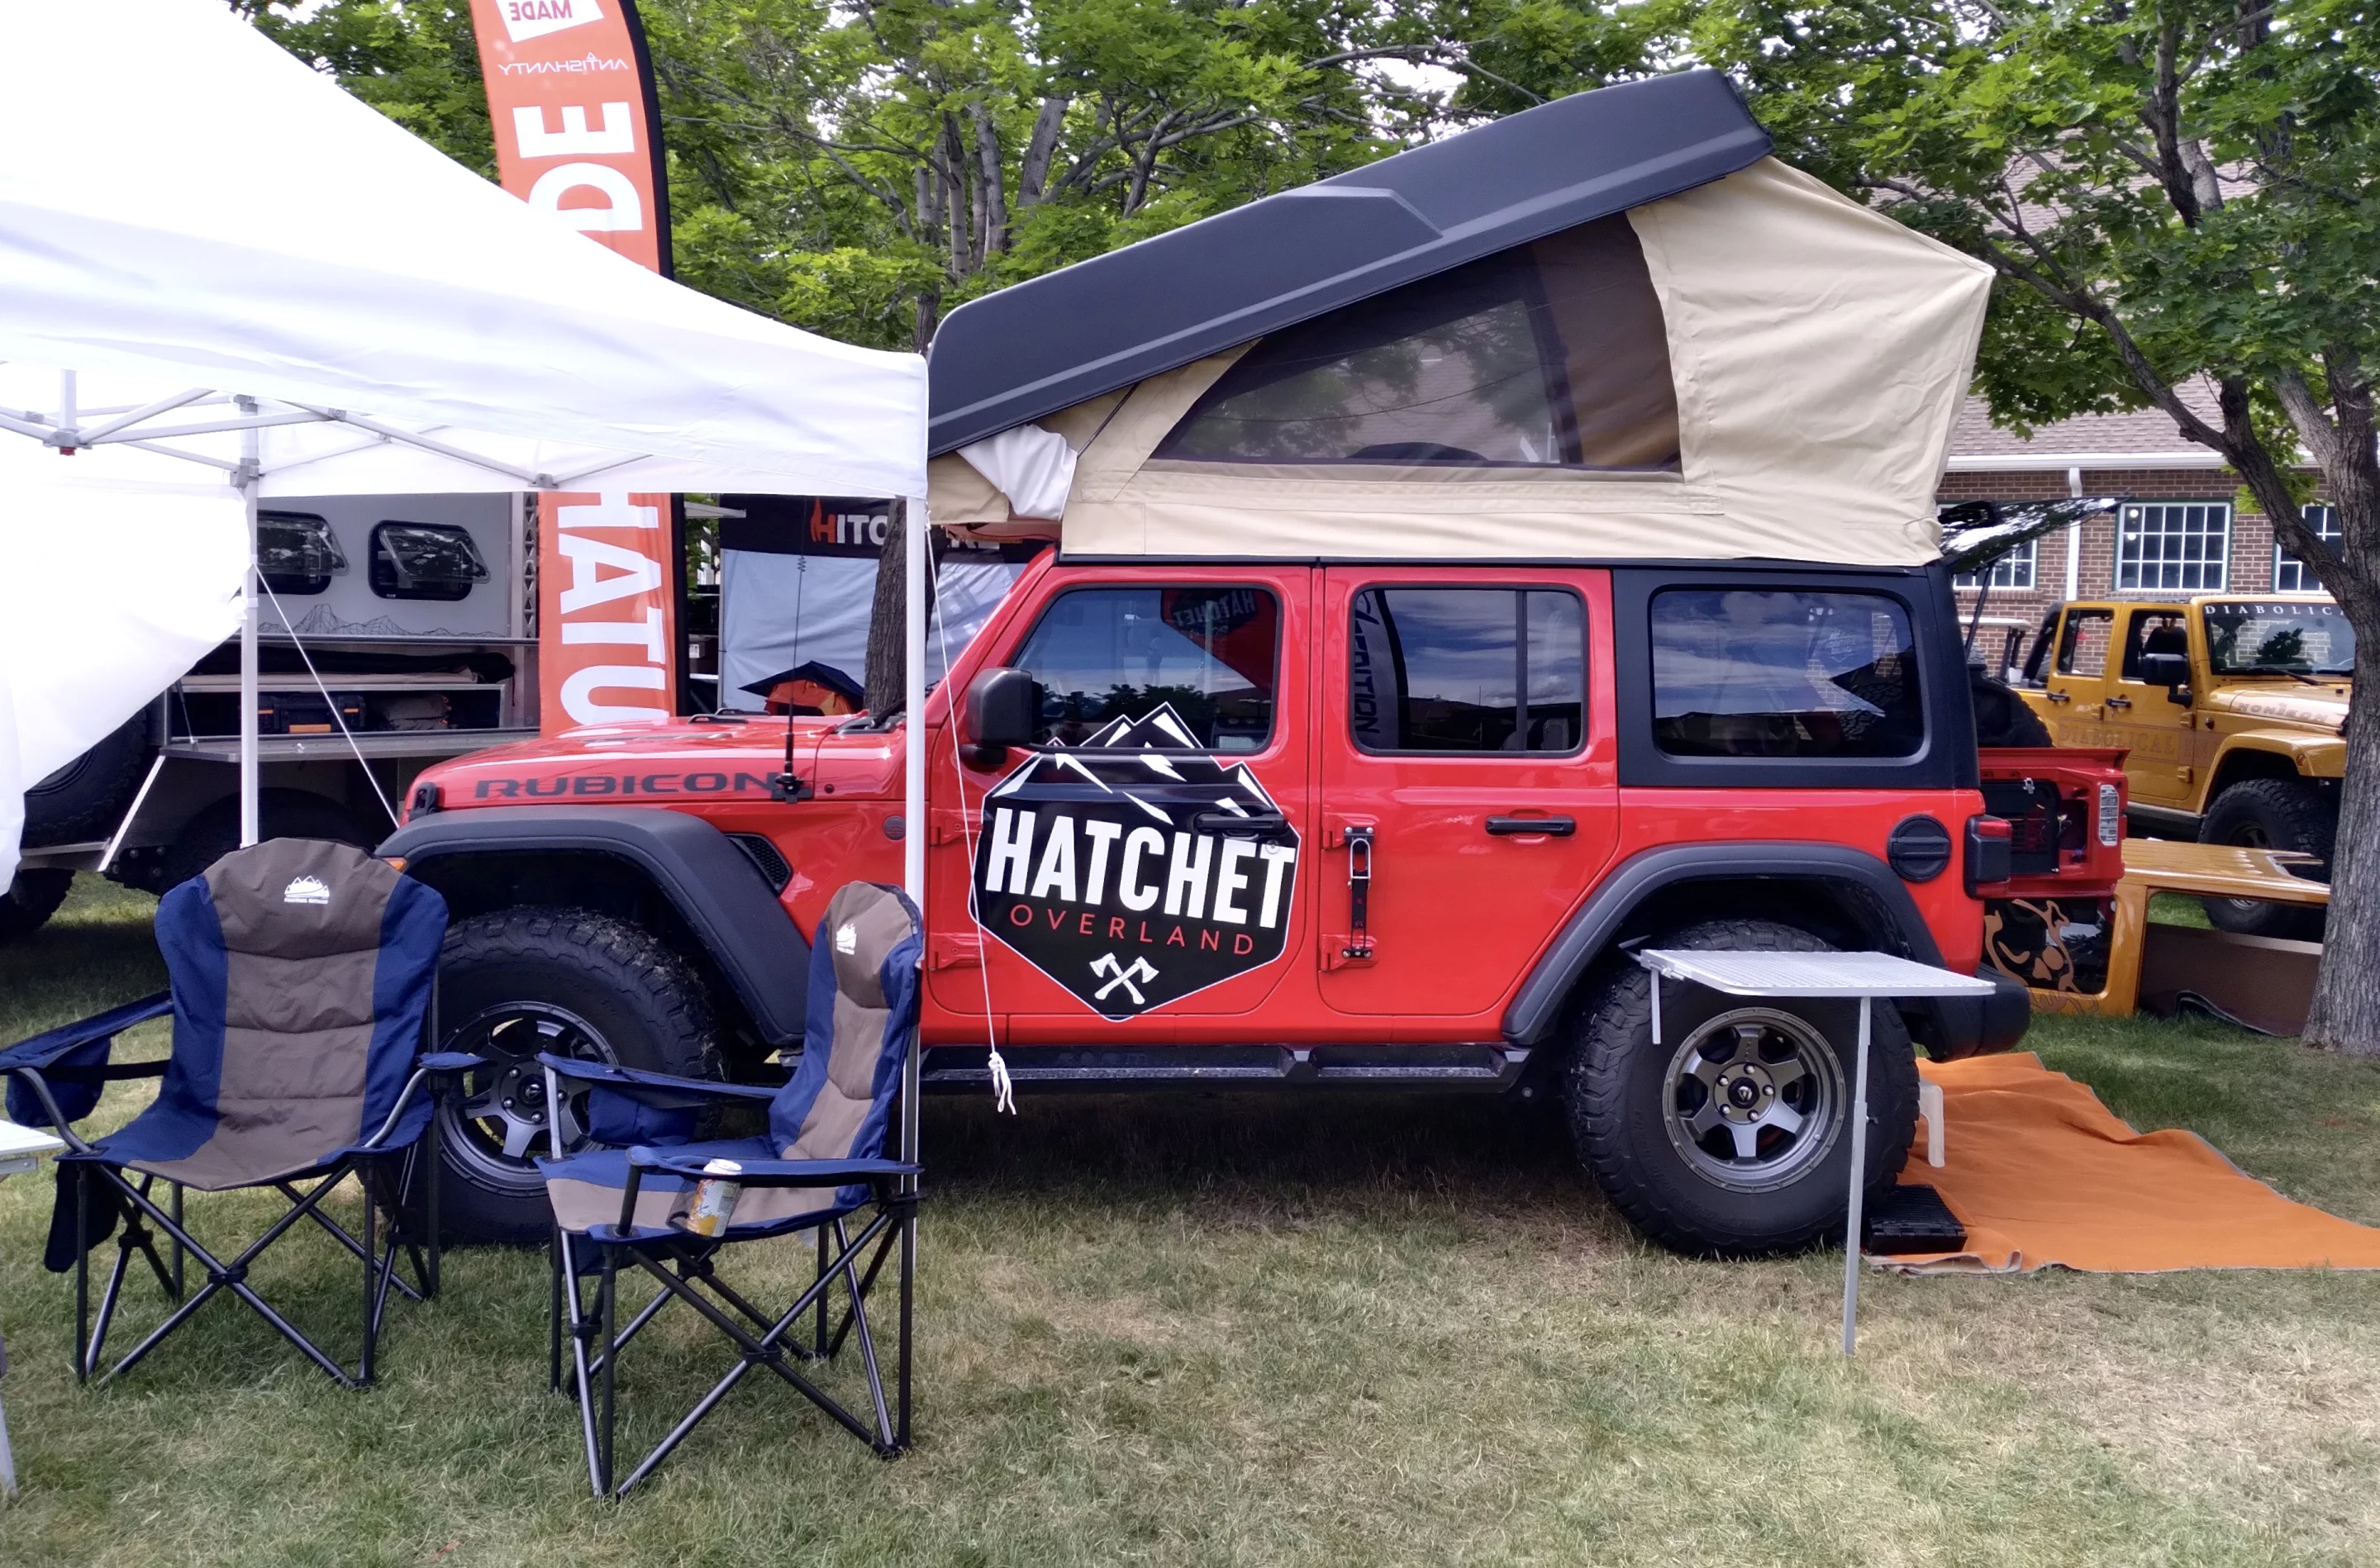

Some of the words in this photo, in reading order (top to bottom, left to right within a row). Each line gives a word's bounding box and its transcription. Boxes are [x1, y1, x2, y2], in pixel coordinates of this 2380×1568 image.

[2204, 606, 2344, 615] DIABOLIC
[474, 772, 779, 799] RUBICON
[985, 807, 1296, 929] HATCHET
[1009, 903, 1254, 956] OVERLAND
